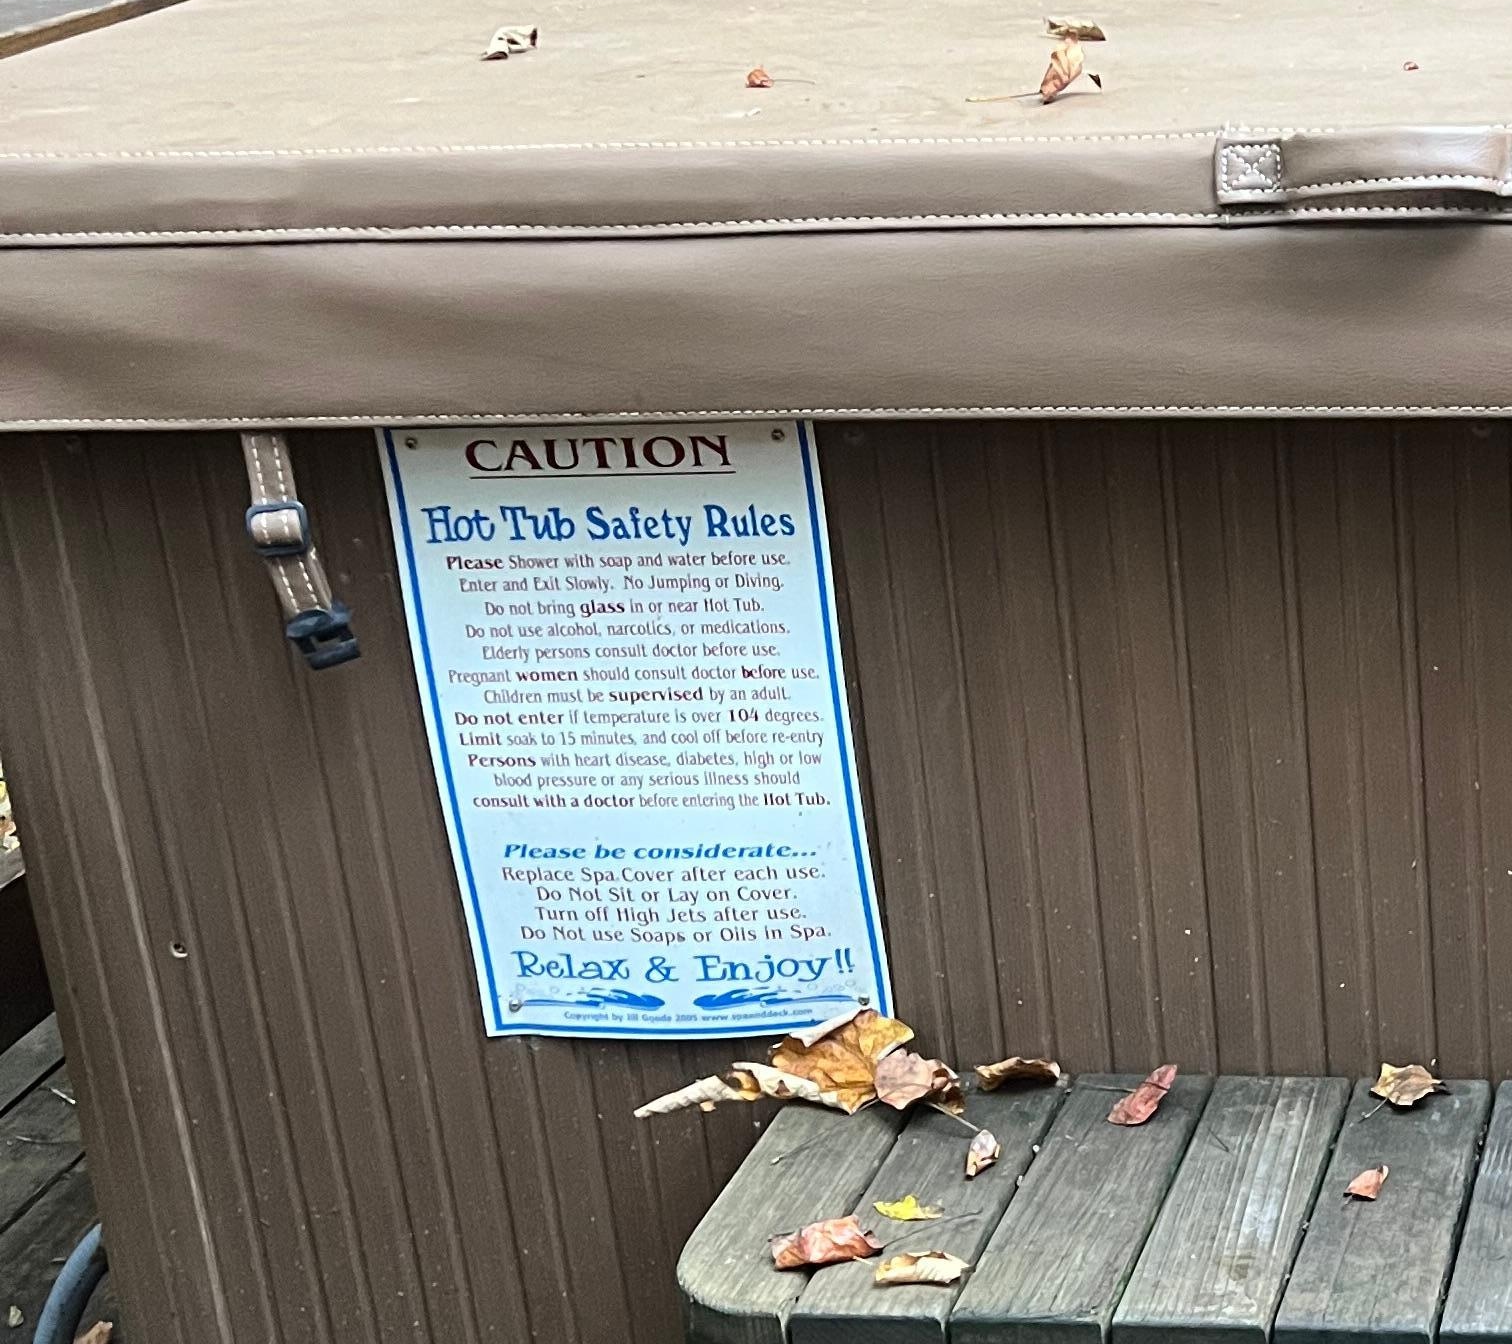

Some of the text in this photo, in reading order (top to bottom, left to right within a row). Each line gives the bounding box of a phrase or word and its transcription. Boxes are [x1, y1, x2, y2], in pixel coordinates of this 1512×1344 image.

[465, 435, 732, 471] CAUTION
[421, 504, 795, 546] Hot Tub Safety Rules
[446, 551, 790, 571] Please Shower with soap and water before use.
[460, 573, 784, 594] Enter and Exit Slowly. No Jumping or Diving.
[485, 598, 764, 618] Do not bring glass in or near Hot Tub.
[465, 624, 484, 638] Do
[490, 624, 513, 637] not
[519, 625, 543, 637] use
[547, 622, 601, 637] alcohol,
[681, 623, 695, 635] or
[701, 619, 790, 634] medications.
[483, 643, 780, 663] Elderly persons consult doctor before use.
[449, 664, 819, 687] Pregnant women should consult doctor before use.
[484, 689, 542, 704] Children
[547, 689, 583, 703] must
[587, 688, 604, 702] be
[609, 687, 703, 704] supervised
[709, 687, 725, 704] by
[730, 689, 746, 700] an
[455, 708, 824, 727] Do not enter if temperature is over 104 degrees.
[459, 729, 824, 747] Limit soak to 15 minutes, and cool off before re-entry
[468, 750, 822, 768] Persons with heart disease, diabetes, high or low
[494, 771, 800, 790] blood pressure or any serious illness should
[473, 792, 830, 810] consult with a doctor before entering the Hot Tub.
[504, 843, 816, 859] Please be considerate...
[502, 866, 825, 885] Replace Spa Cover after each use.
[537, 886, 797, 906] Do Not Sit or Lay on Cover.
[535, 907, 807, 926] Turn off High Jets after use.
[521, 924, 831, 946] Do Not use Soaps or Oils in Spa.
[510, 948, 855, 983] Relax & Enjoy!!
[612, 1011, 623, 1023] by
